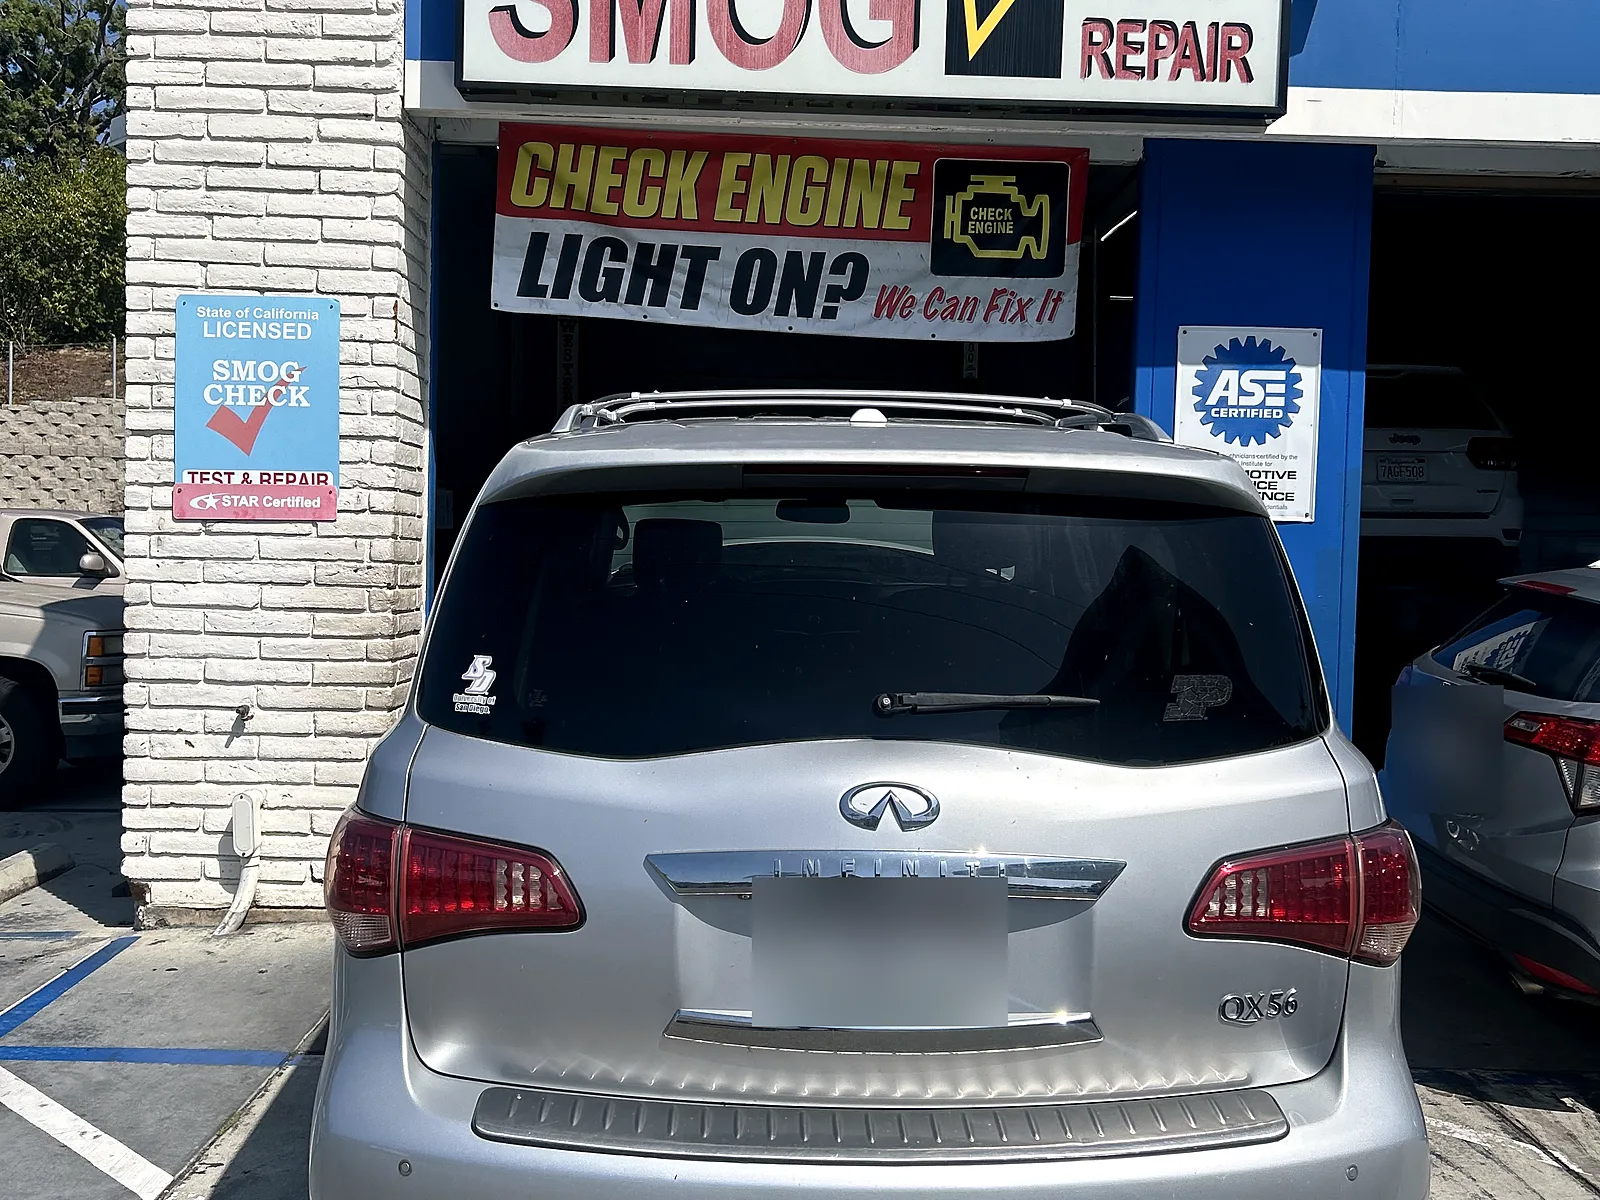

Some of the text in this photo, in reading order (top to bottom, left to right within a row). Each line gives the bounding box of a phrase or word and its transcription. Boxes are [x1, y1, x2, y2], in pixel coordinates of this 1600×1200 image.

[488, 0, 922, 74] SMOG
[1079, 17, 1254, 84] REPAIR
[510, 141, 920, 230] CHECK ENGINE
[970, 206, 1013, 221] CHECK
[967, 221, 1014, 234] ENGINE
[516, 231, 870, 320] LIGHT ON?
[196, 307, 319, 320] State of California
[873, 284, 1064, 323] We Can Fix It
[203, 321, 312, 340] LICENSED
[212, 359, 302, 382] SMOG
[203, 384, 311, 407] CHECK
[1205, 370, 1287, 407] ASE
[1211, 408, 1284, 419] CERTIFIED
[187, 471, 329, 485] TEST & REPAIR
[221, 495, 321, 508] STAR Certified
[773, 858, 1006, 877] INFINITI
[1218, 987, 1298, 1027] QX56
